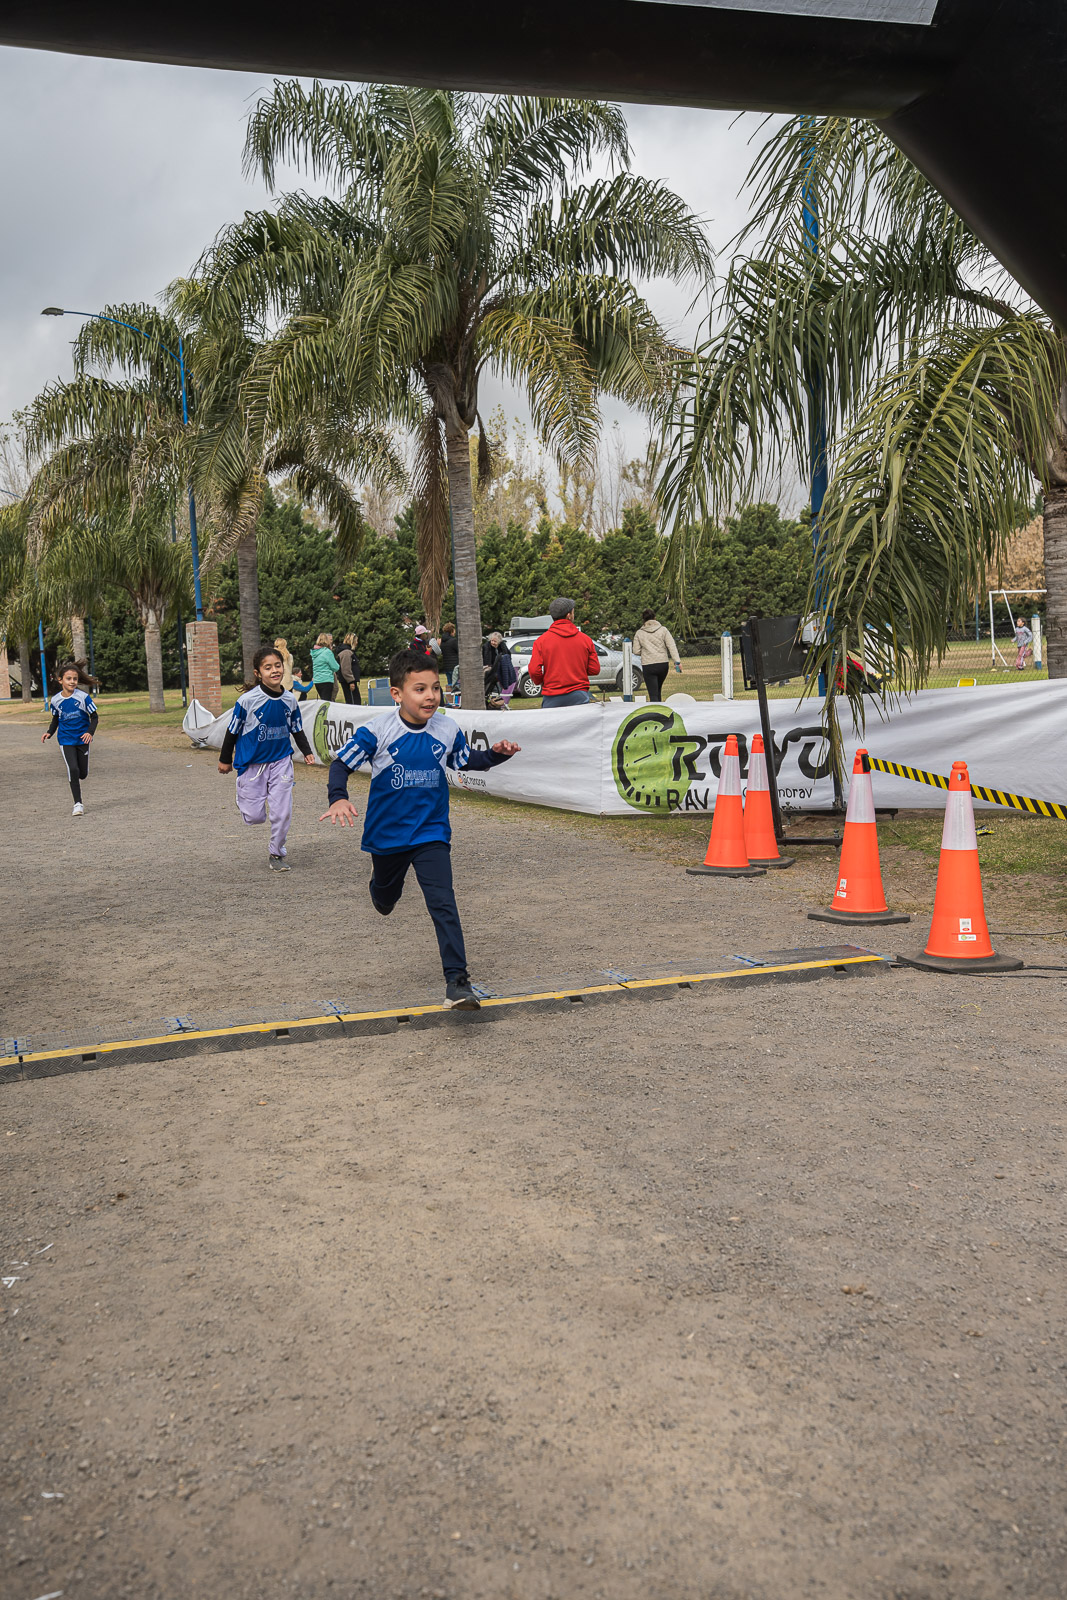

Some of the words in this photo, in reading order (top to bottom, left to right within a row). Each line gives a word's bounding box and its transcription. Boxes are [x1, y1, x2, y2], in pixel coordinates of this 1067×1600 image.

[258, 723, 268, 742] 3
[391, 763, 404, 790] 3
[666, 788, 710, 811] RAV
